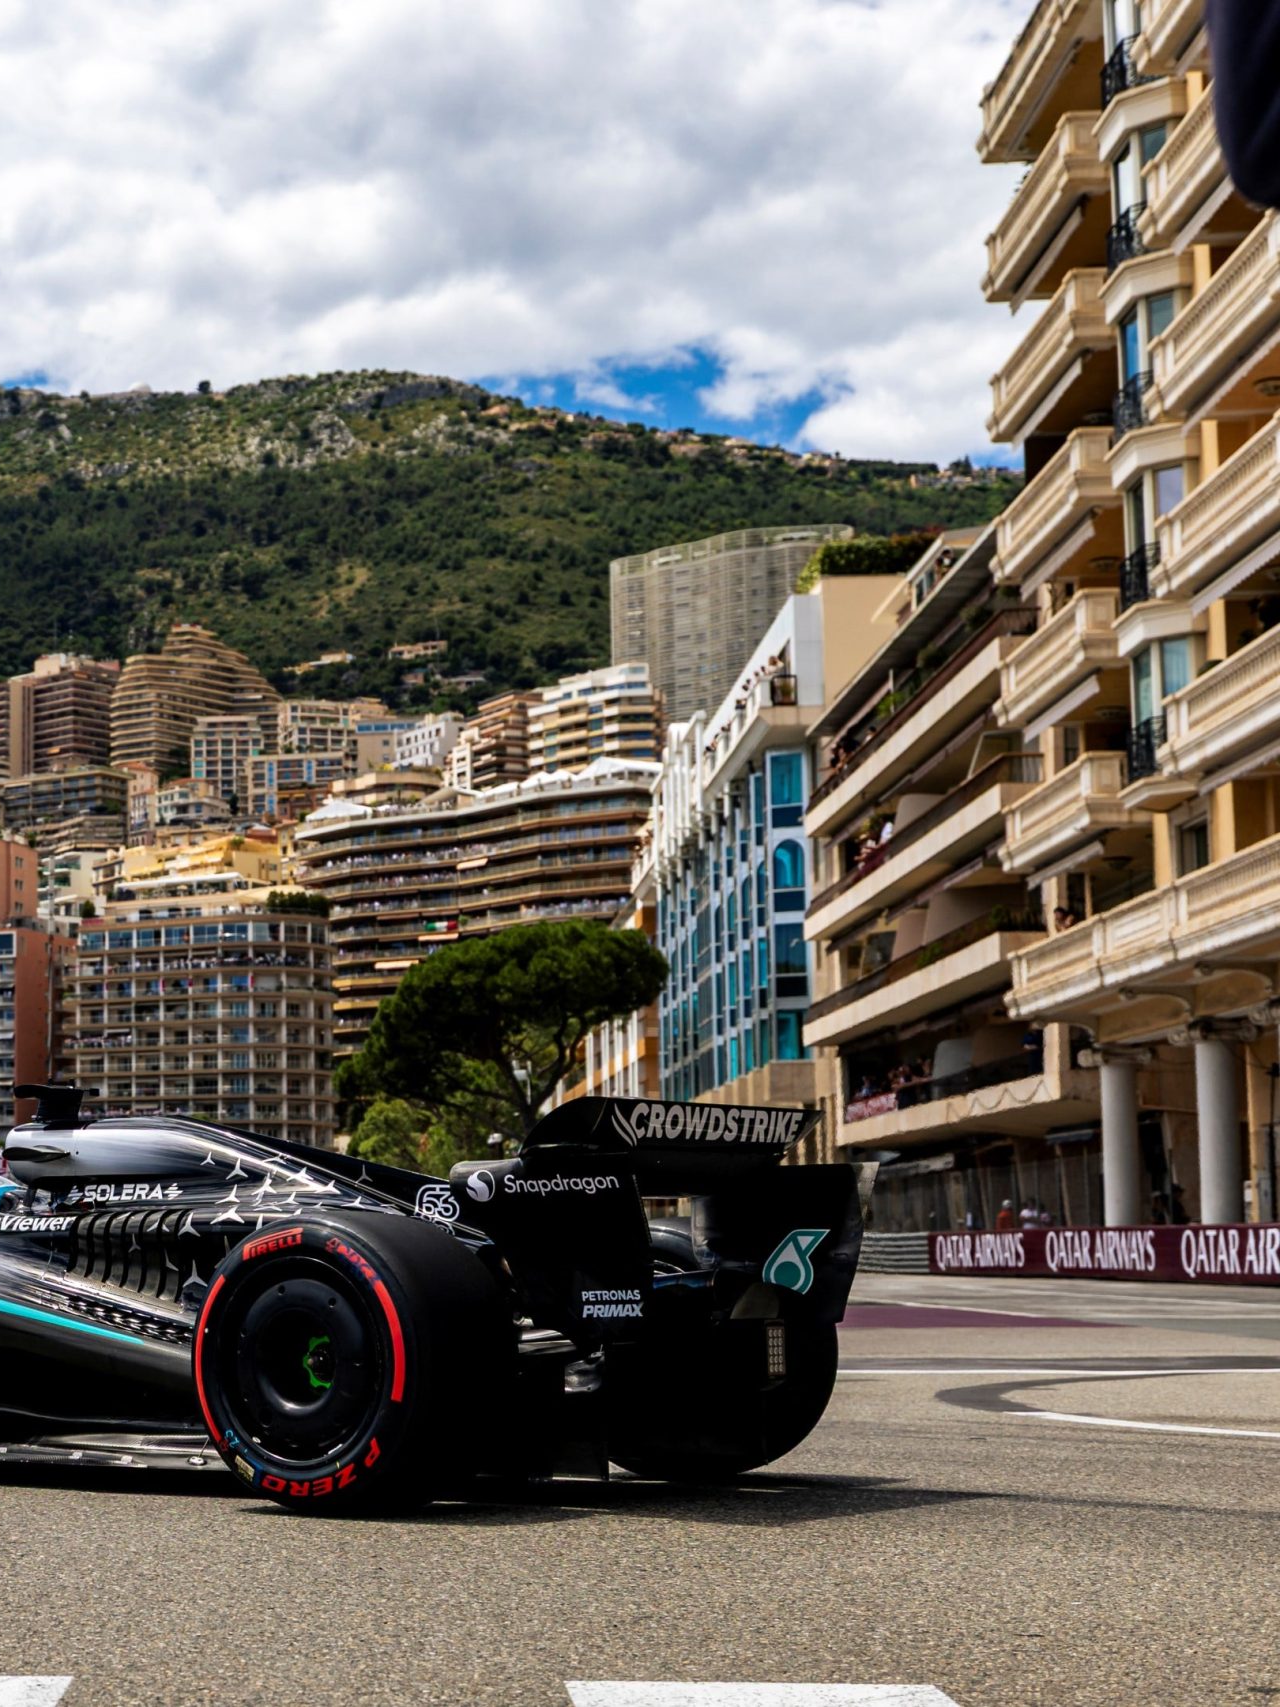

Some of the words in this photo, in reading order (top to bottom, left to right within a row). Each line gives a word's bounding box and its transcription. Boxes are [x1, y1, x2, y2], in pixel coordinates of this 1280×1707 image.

[630, 1102, 804, 1143] CROWDSTRIKE
[83, 1183, 163, 1202] SOLERA
[503, 1173, 619, 1197] Snapdragon
[242, 1226, 304, 1261] PIRELLI
[936, 1235, 973, 1270] QATAR
[974, 1233, 1025, 1268] AIRWAYS
[1045, 1231, 1093, 1271] QATAR
[1094, 1231, 1156, 1271] AIRWAYS
[1181, 1229, 1241, 1278] QATAR
[581, 1289, 641, 1302] PETRONAS
[581, 1302, 644, 1318] PRIMAX
[260, 1462, 358, 1497] ZERO
